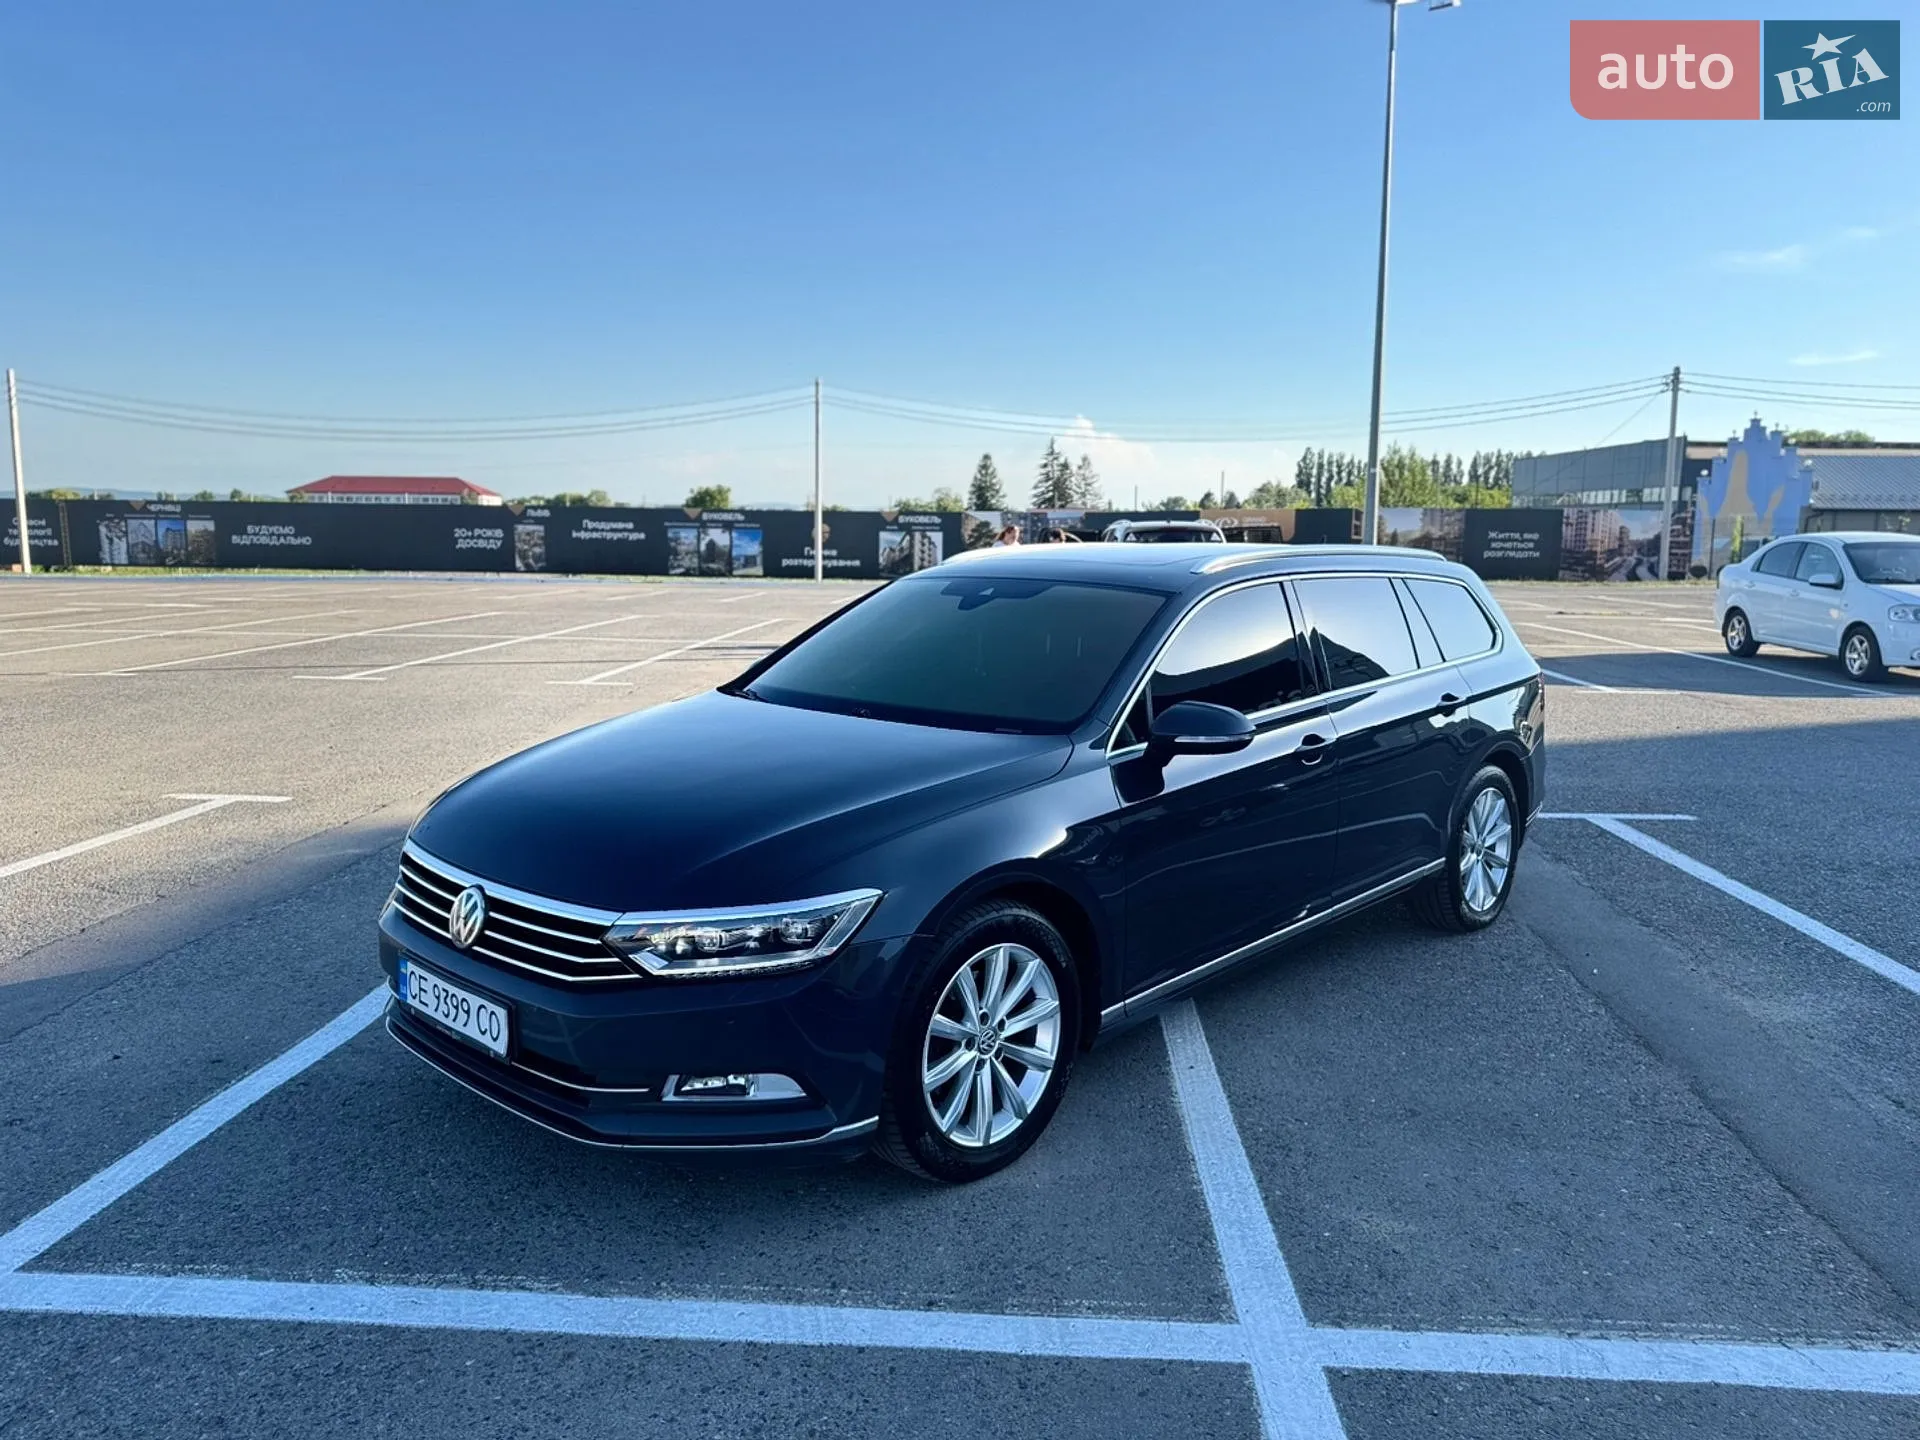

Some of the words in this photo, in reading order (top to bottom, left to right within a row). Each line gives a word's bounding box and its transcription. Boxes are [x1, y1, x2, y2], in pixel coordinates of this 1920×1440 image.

[453, 528, 472, 538] 20+
[473, 528, 504, 538] РОКІВ
[408, 971, 429, 1007] CE
[432, 983, 472, 1028] 9399
[476, 1004, 501, 1043] CO
